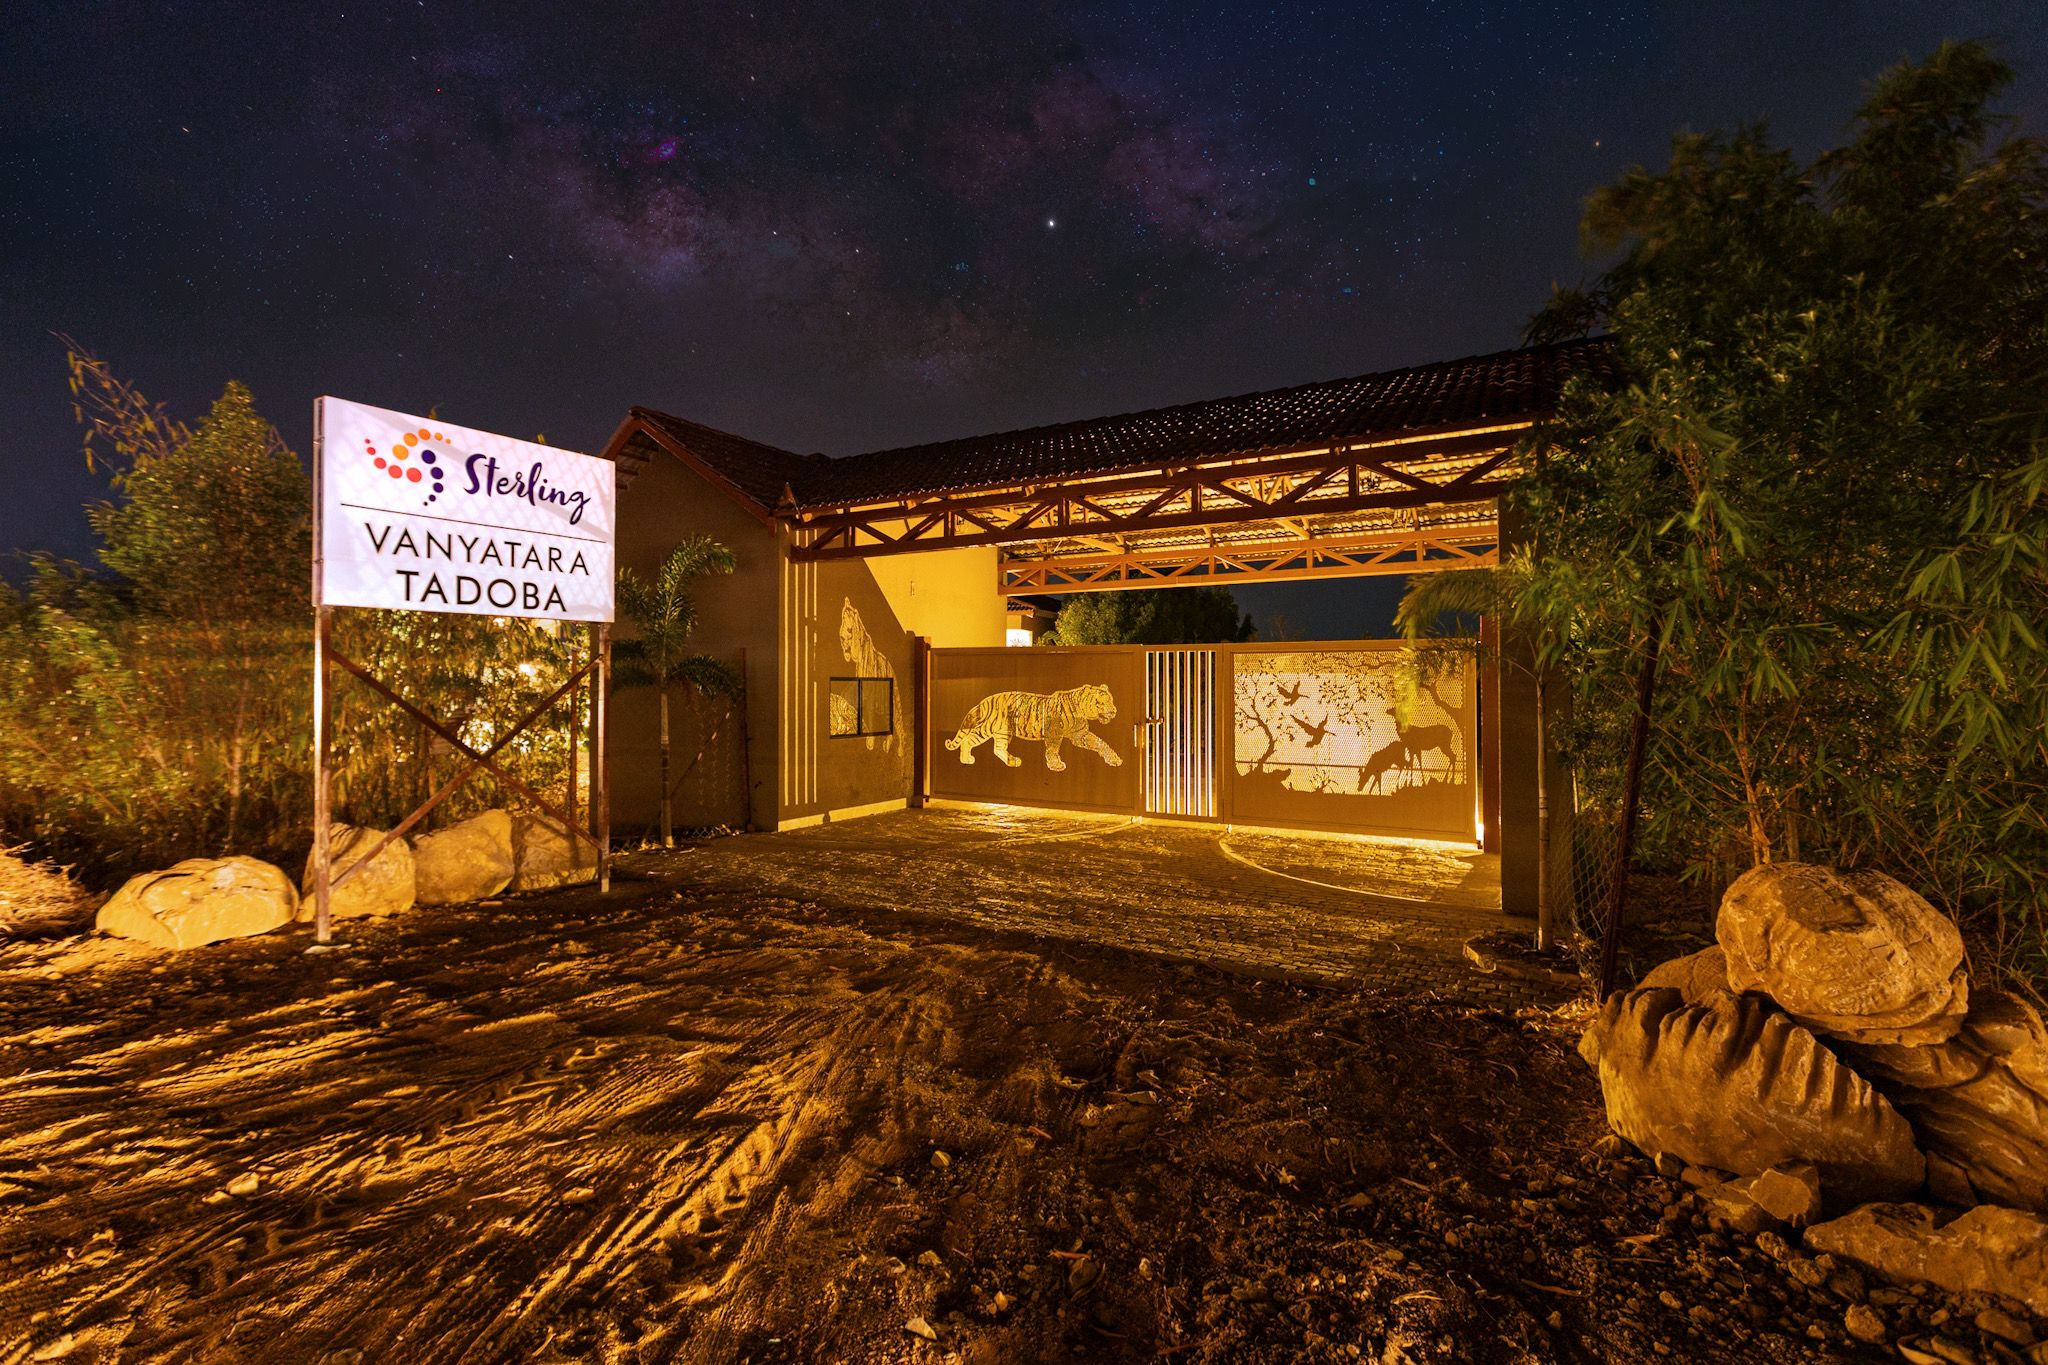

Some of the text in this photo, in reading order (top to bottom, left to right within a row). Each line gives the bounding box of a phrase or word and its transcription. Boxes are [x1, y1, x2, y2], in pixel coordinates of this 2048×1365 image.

[464, 453, 591, 525] Sterling
[365, 523, 589, 575] VANYATARA
[396, 569, 567, 612] TADOBA
